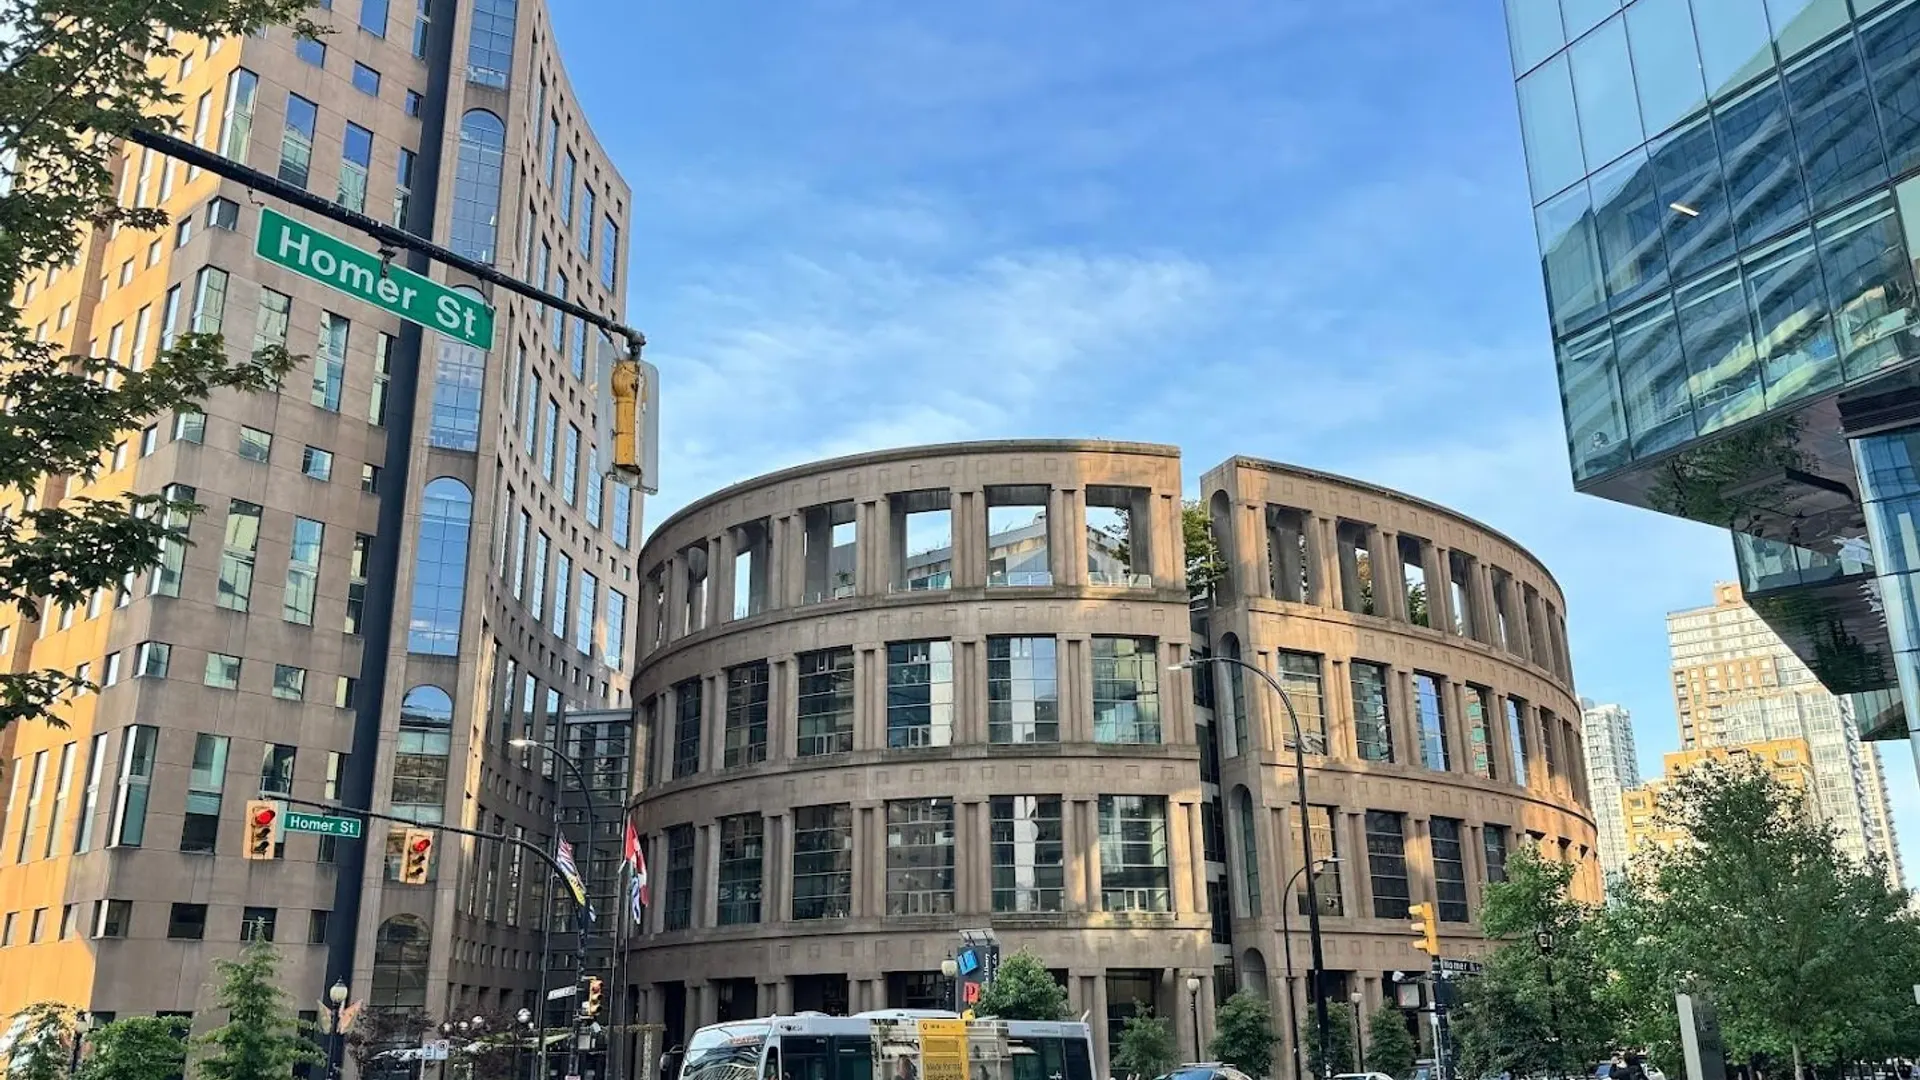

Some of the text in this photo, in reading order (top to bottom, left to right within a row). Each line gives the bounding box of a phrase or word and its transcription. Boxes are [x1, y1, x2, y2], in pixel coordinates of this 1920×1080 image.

[278, 225, 476, 338] Homer St
[290, 816, 354, 834] Homer St
